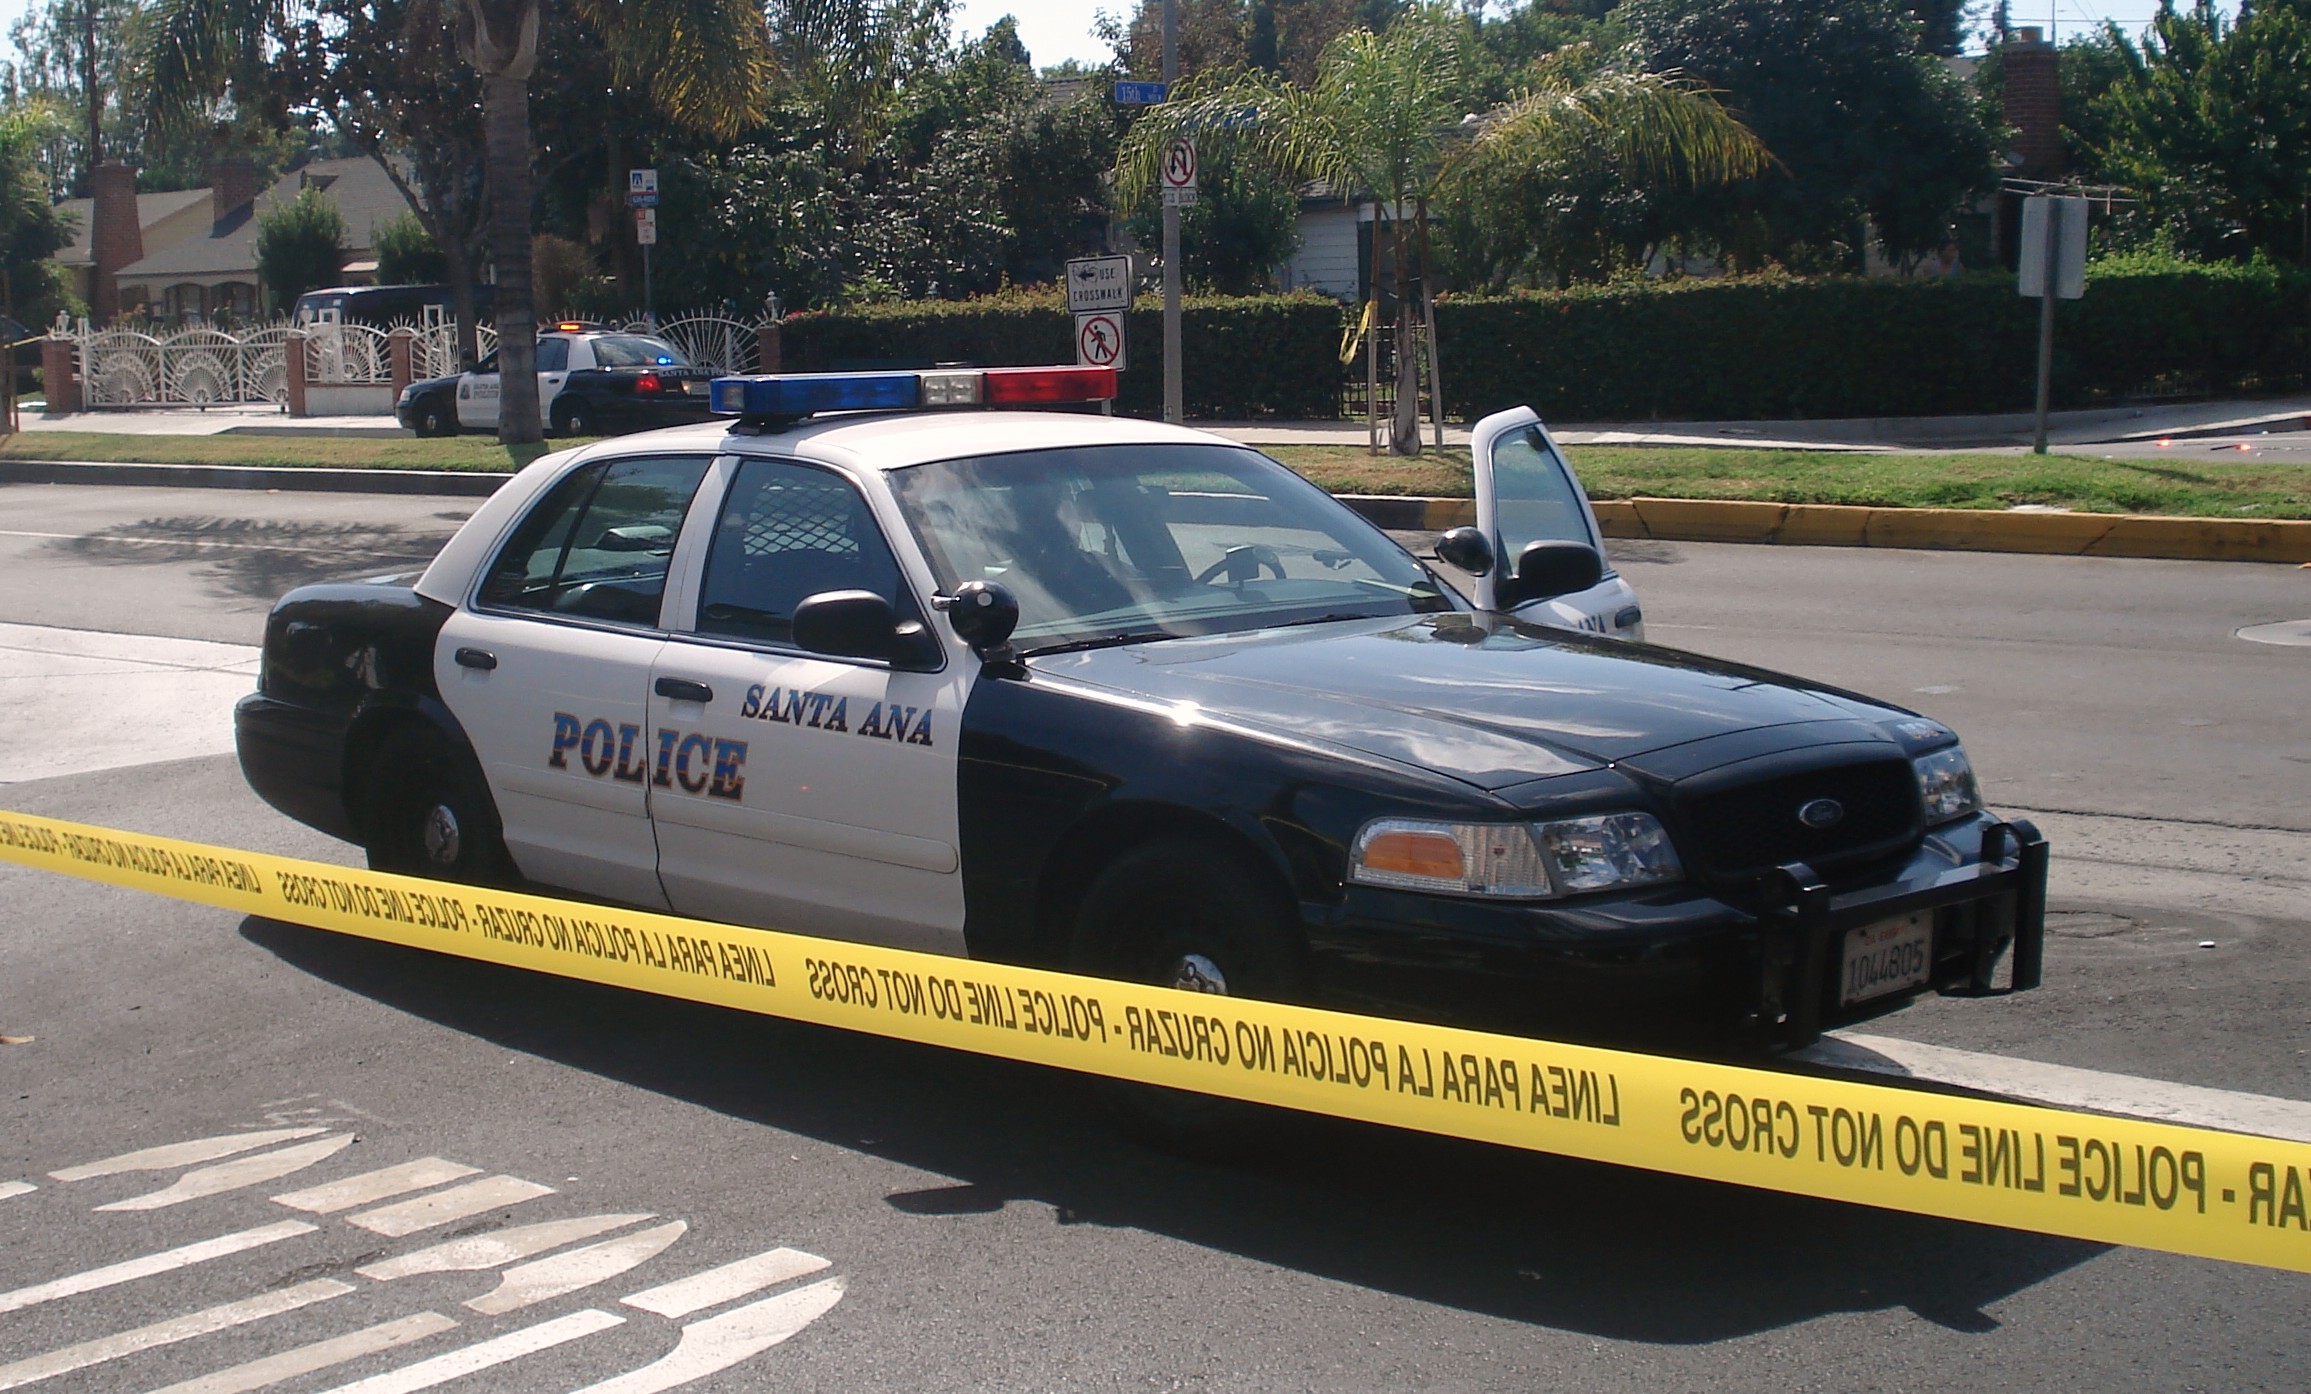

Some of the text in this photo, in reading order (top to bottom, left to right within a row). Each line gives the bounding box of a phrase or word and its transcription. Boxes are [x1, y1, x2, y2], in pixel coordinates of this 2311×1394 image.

[1122, 86, 1141, 101] 15th
[1099, 267, 1115, 279] USE
[1073, 288, 1122, 302] CROSSWALK
[741, 684, 933, 747] SANTA ANA
[548, 711, 749, 801] POLICE
